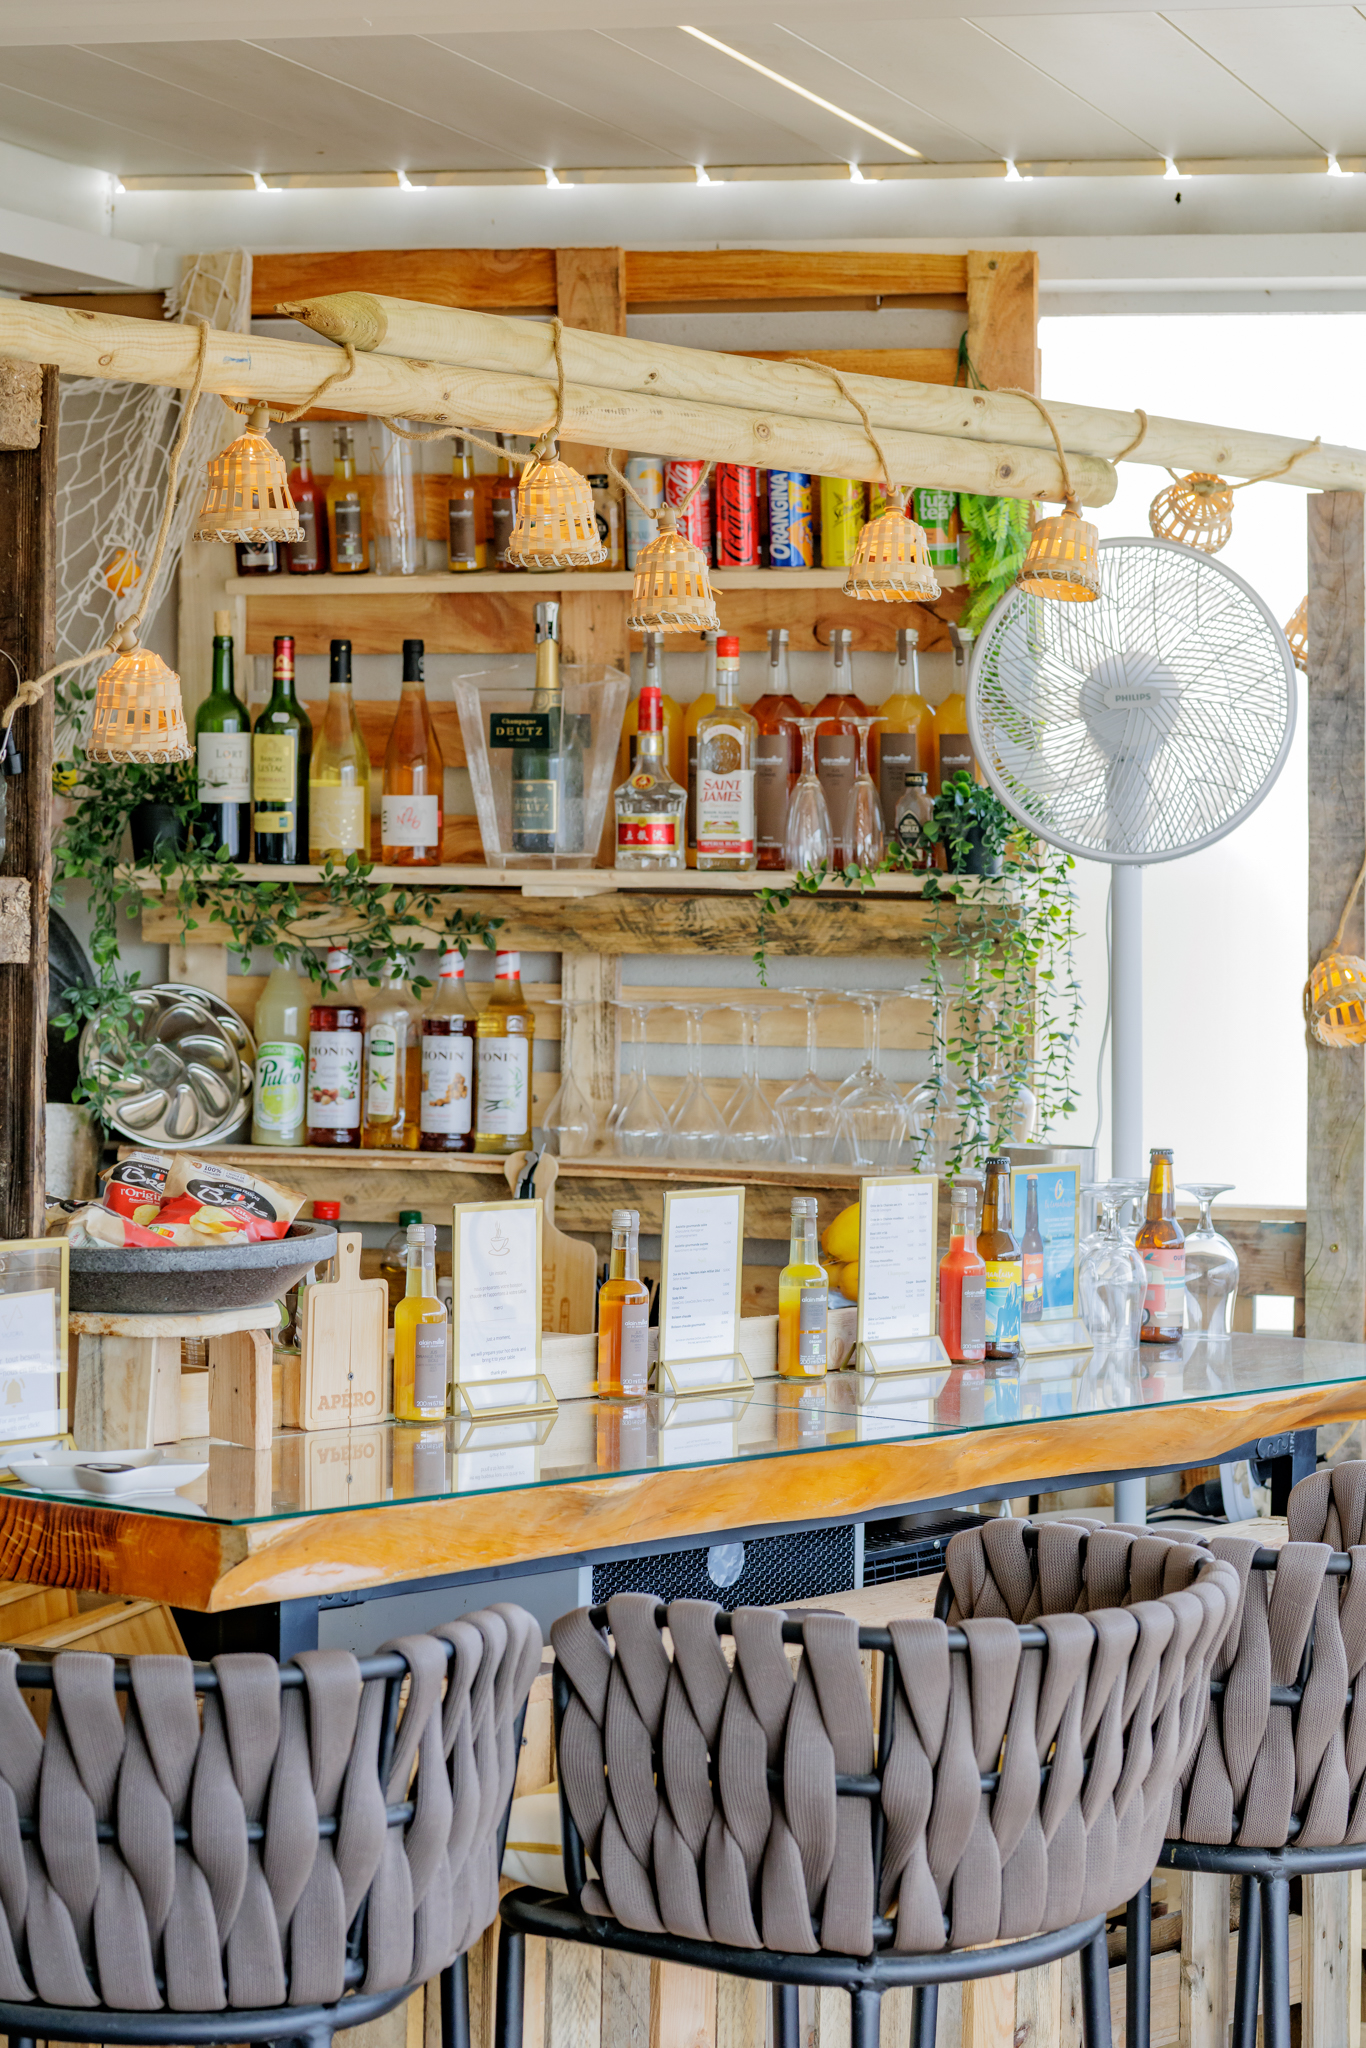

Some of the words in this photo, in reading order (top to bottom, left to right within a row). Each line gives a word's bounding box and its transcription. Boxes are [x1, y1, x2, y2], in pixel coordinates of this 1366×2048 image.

[770, 472, 791, 560] ORANGINA
[920, 507, 949, 520] tea
[1115, 693, 1151, 702] PHILIPS
[495, 726, 543, 736] DEUTZ
[703, 779, 742, 791] SAINT
[700, 791, 743, 803] JAMES
[260, 1060, 301, 1088] Pulco
[204, 1165, 222, 1174] 100%
[5, 1355, 19, 1364] tout
[19, 1352, 41, 1362] besoin
[317, 1388, 376, 1411] APÉRO
